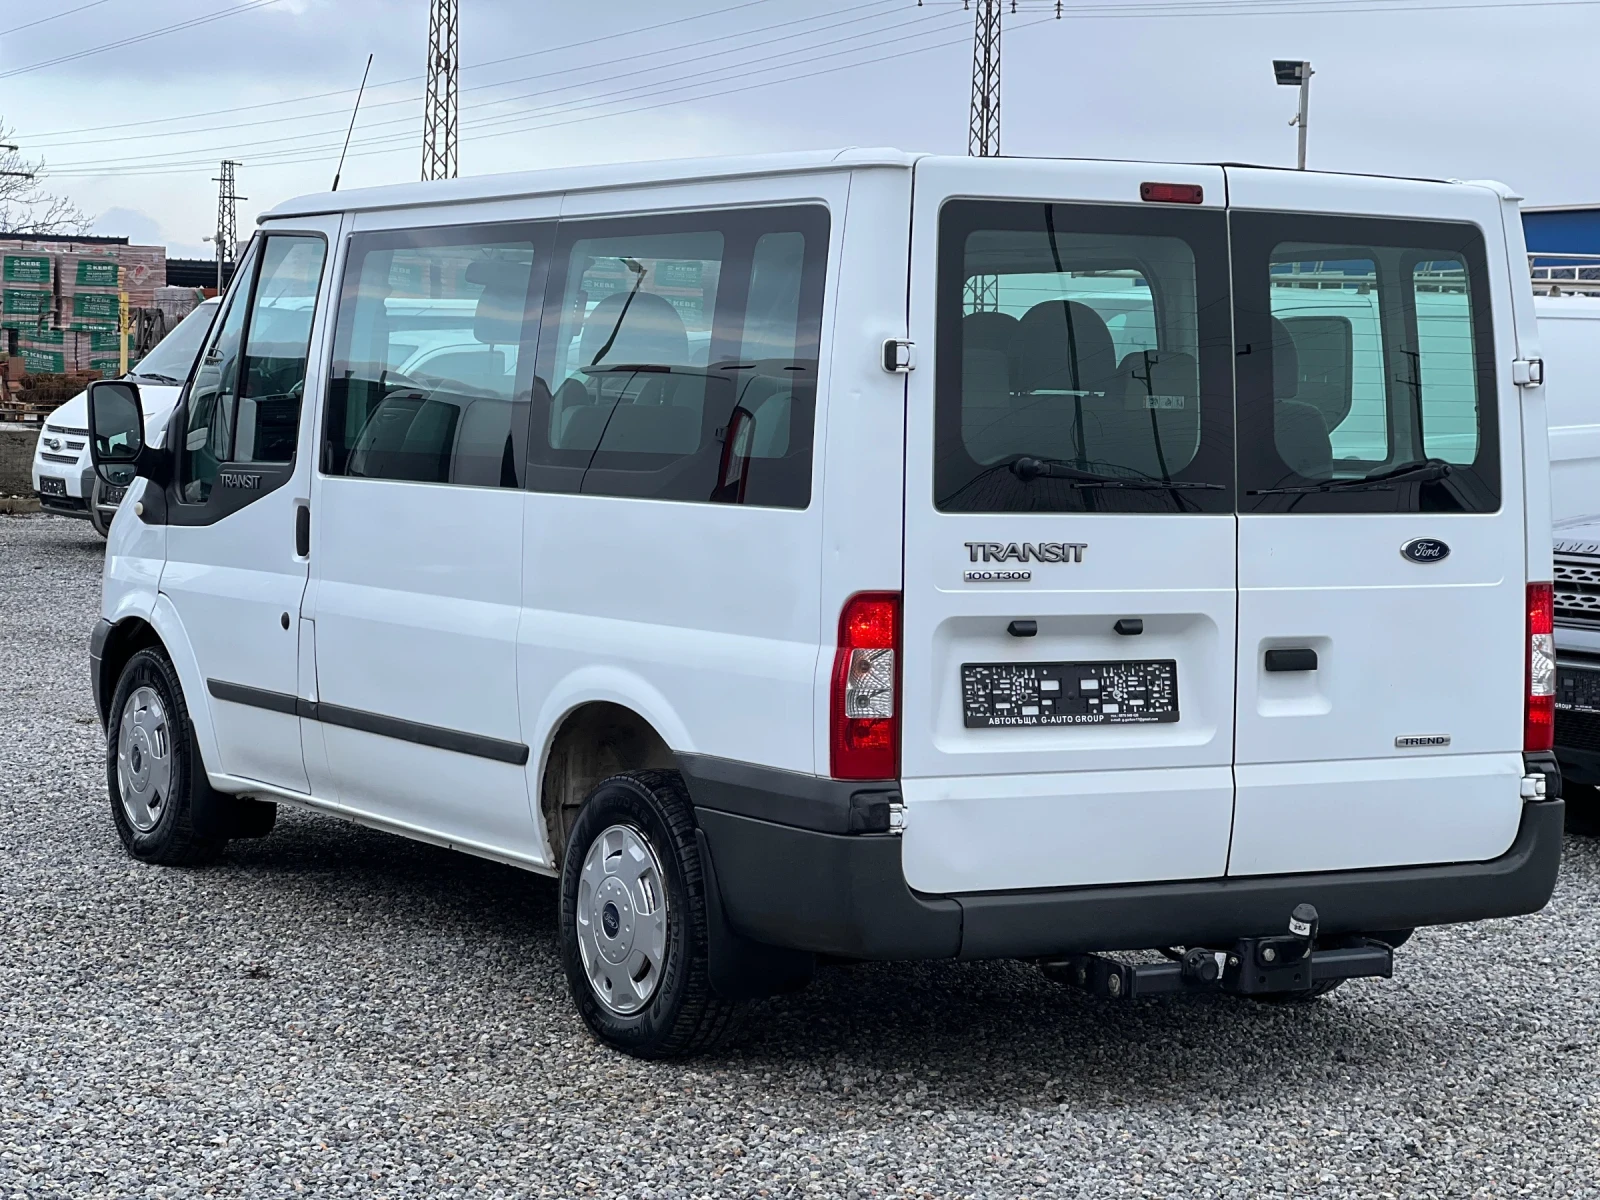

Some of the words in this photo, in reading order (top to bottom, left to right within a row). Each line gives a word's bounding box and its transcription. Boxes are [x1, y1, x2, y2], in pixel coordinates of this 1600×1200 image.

[593, 281, 615, 289] KEBE
[673, 300, 696, 308] KEBE
[219, 473, 261, 489] TRANSIT
[964, 541, 1088, 563] TRANSIT
[1414, 542, 1441, 557] Ford
[966, 571, 992, 581] 100
[994, 571, 1031, 581] T300
[988, 716, 1038, 725] АВТОКЪЩА
[1041, 715, 1073, 724] G-AUTO
[1075, 714, 1105, 723] GROUP
[1402, 736, 1445, 746] TREND
